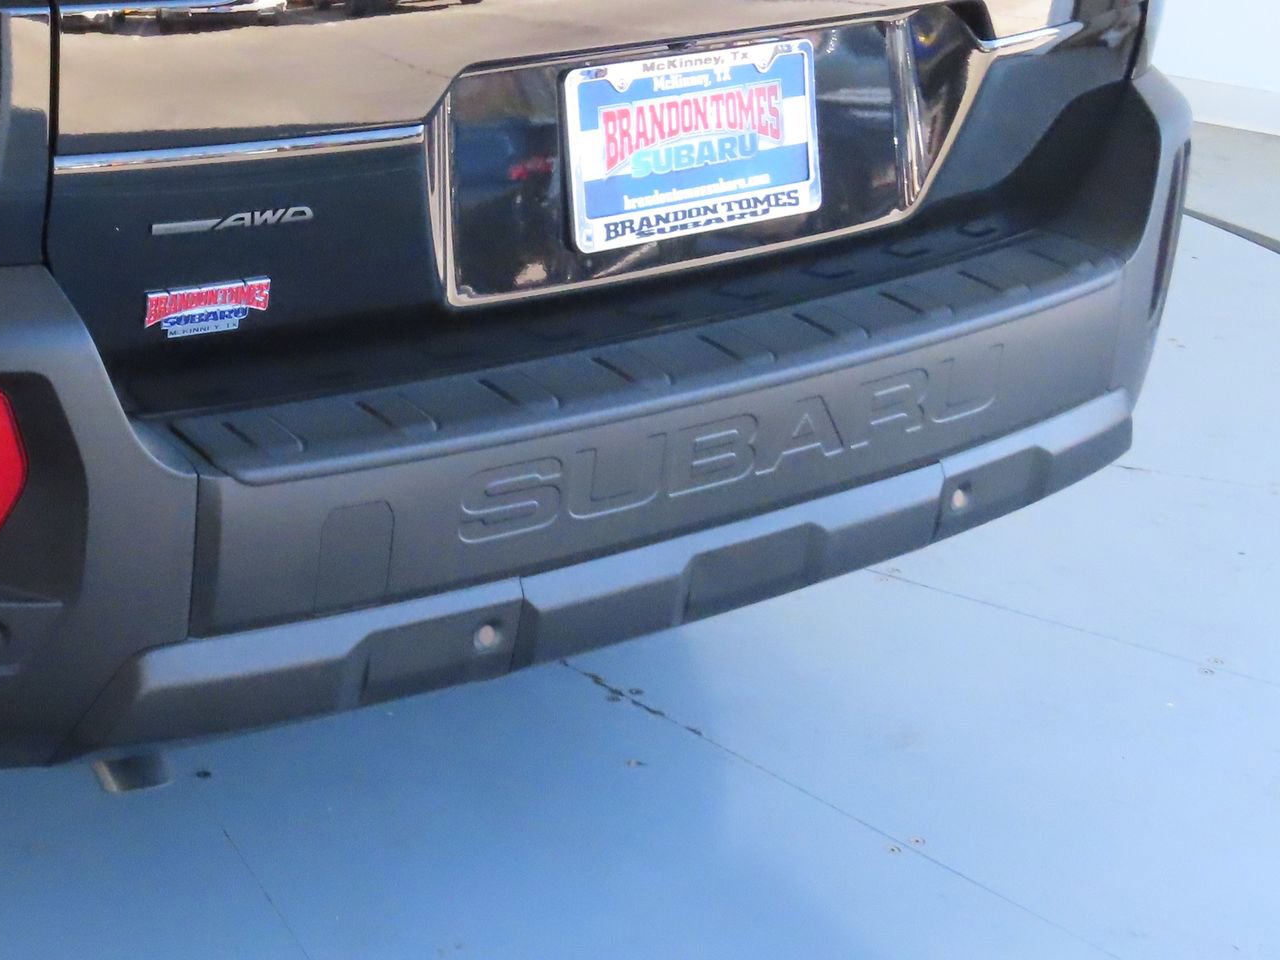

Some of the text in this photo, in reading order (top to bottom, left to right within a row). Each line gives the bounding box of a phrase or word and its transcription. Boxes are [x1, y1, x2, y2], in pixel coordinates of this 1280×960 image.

[642, 56, 726, 74] McKinney,
[602, 84, 782, 171] BRANDON TOMES
[631, 134, 761, 178] SUBARU
[212, 206, 314, 231] AWD
[604, 204, 718, 242] BRANDON
[721, 189, 800, 215] TOMES
[635, 208, 770, 239] SUBARU
[163, 307, 246, 327] SUBARU
[458, 343, 1004, 543] SUBARU
